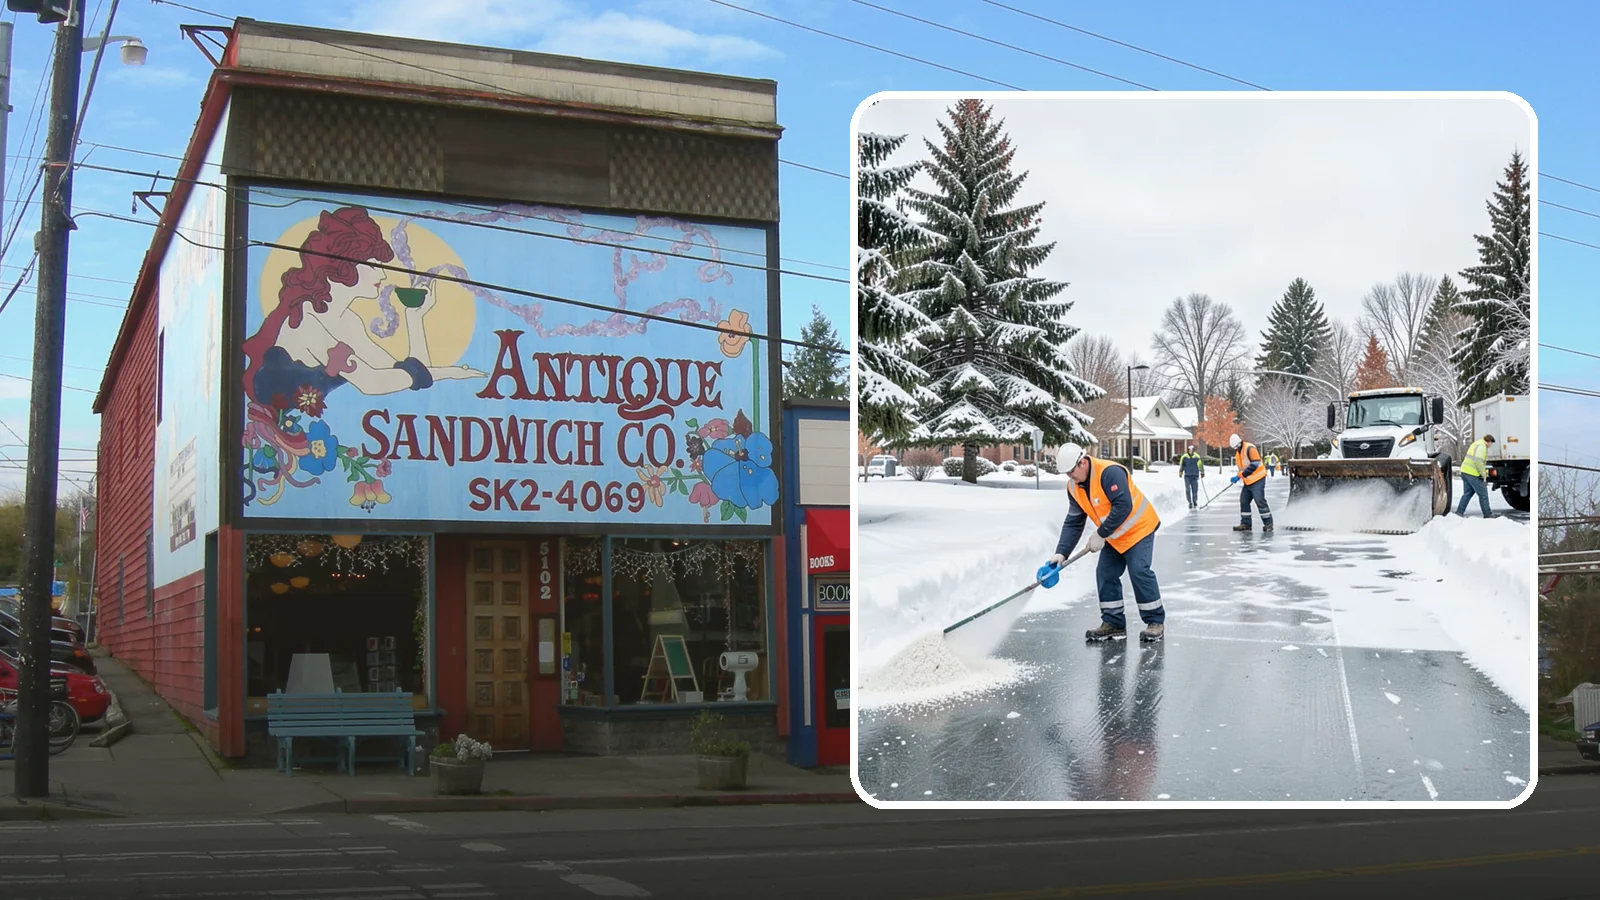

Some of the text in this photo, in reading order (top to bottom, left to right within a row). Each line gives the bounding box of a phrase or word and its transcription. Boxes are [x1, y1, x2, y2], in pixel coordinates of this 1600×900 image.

[476, 329, 724, 421] ANTIQUE
[361, 408, 685, 469] SANDWICH CO.
[468, 477, 646, 514] SK2-4069
[540, 541, 551, 600] 5102
[809, 555, 835, 569] BOOKS
